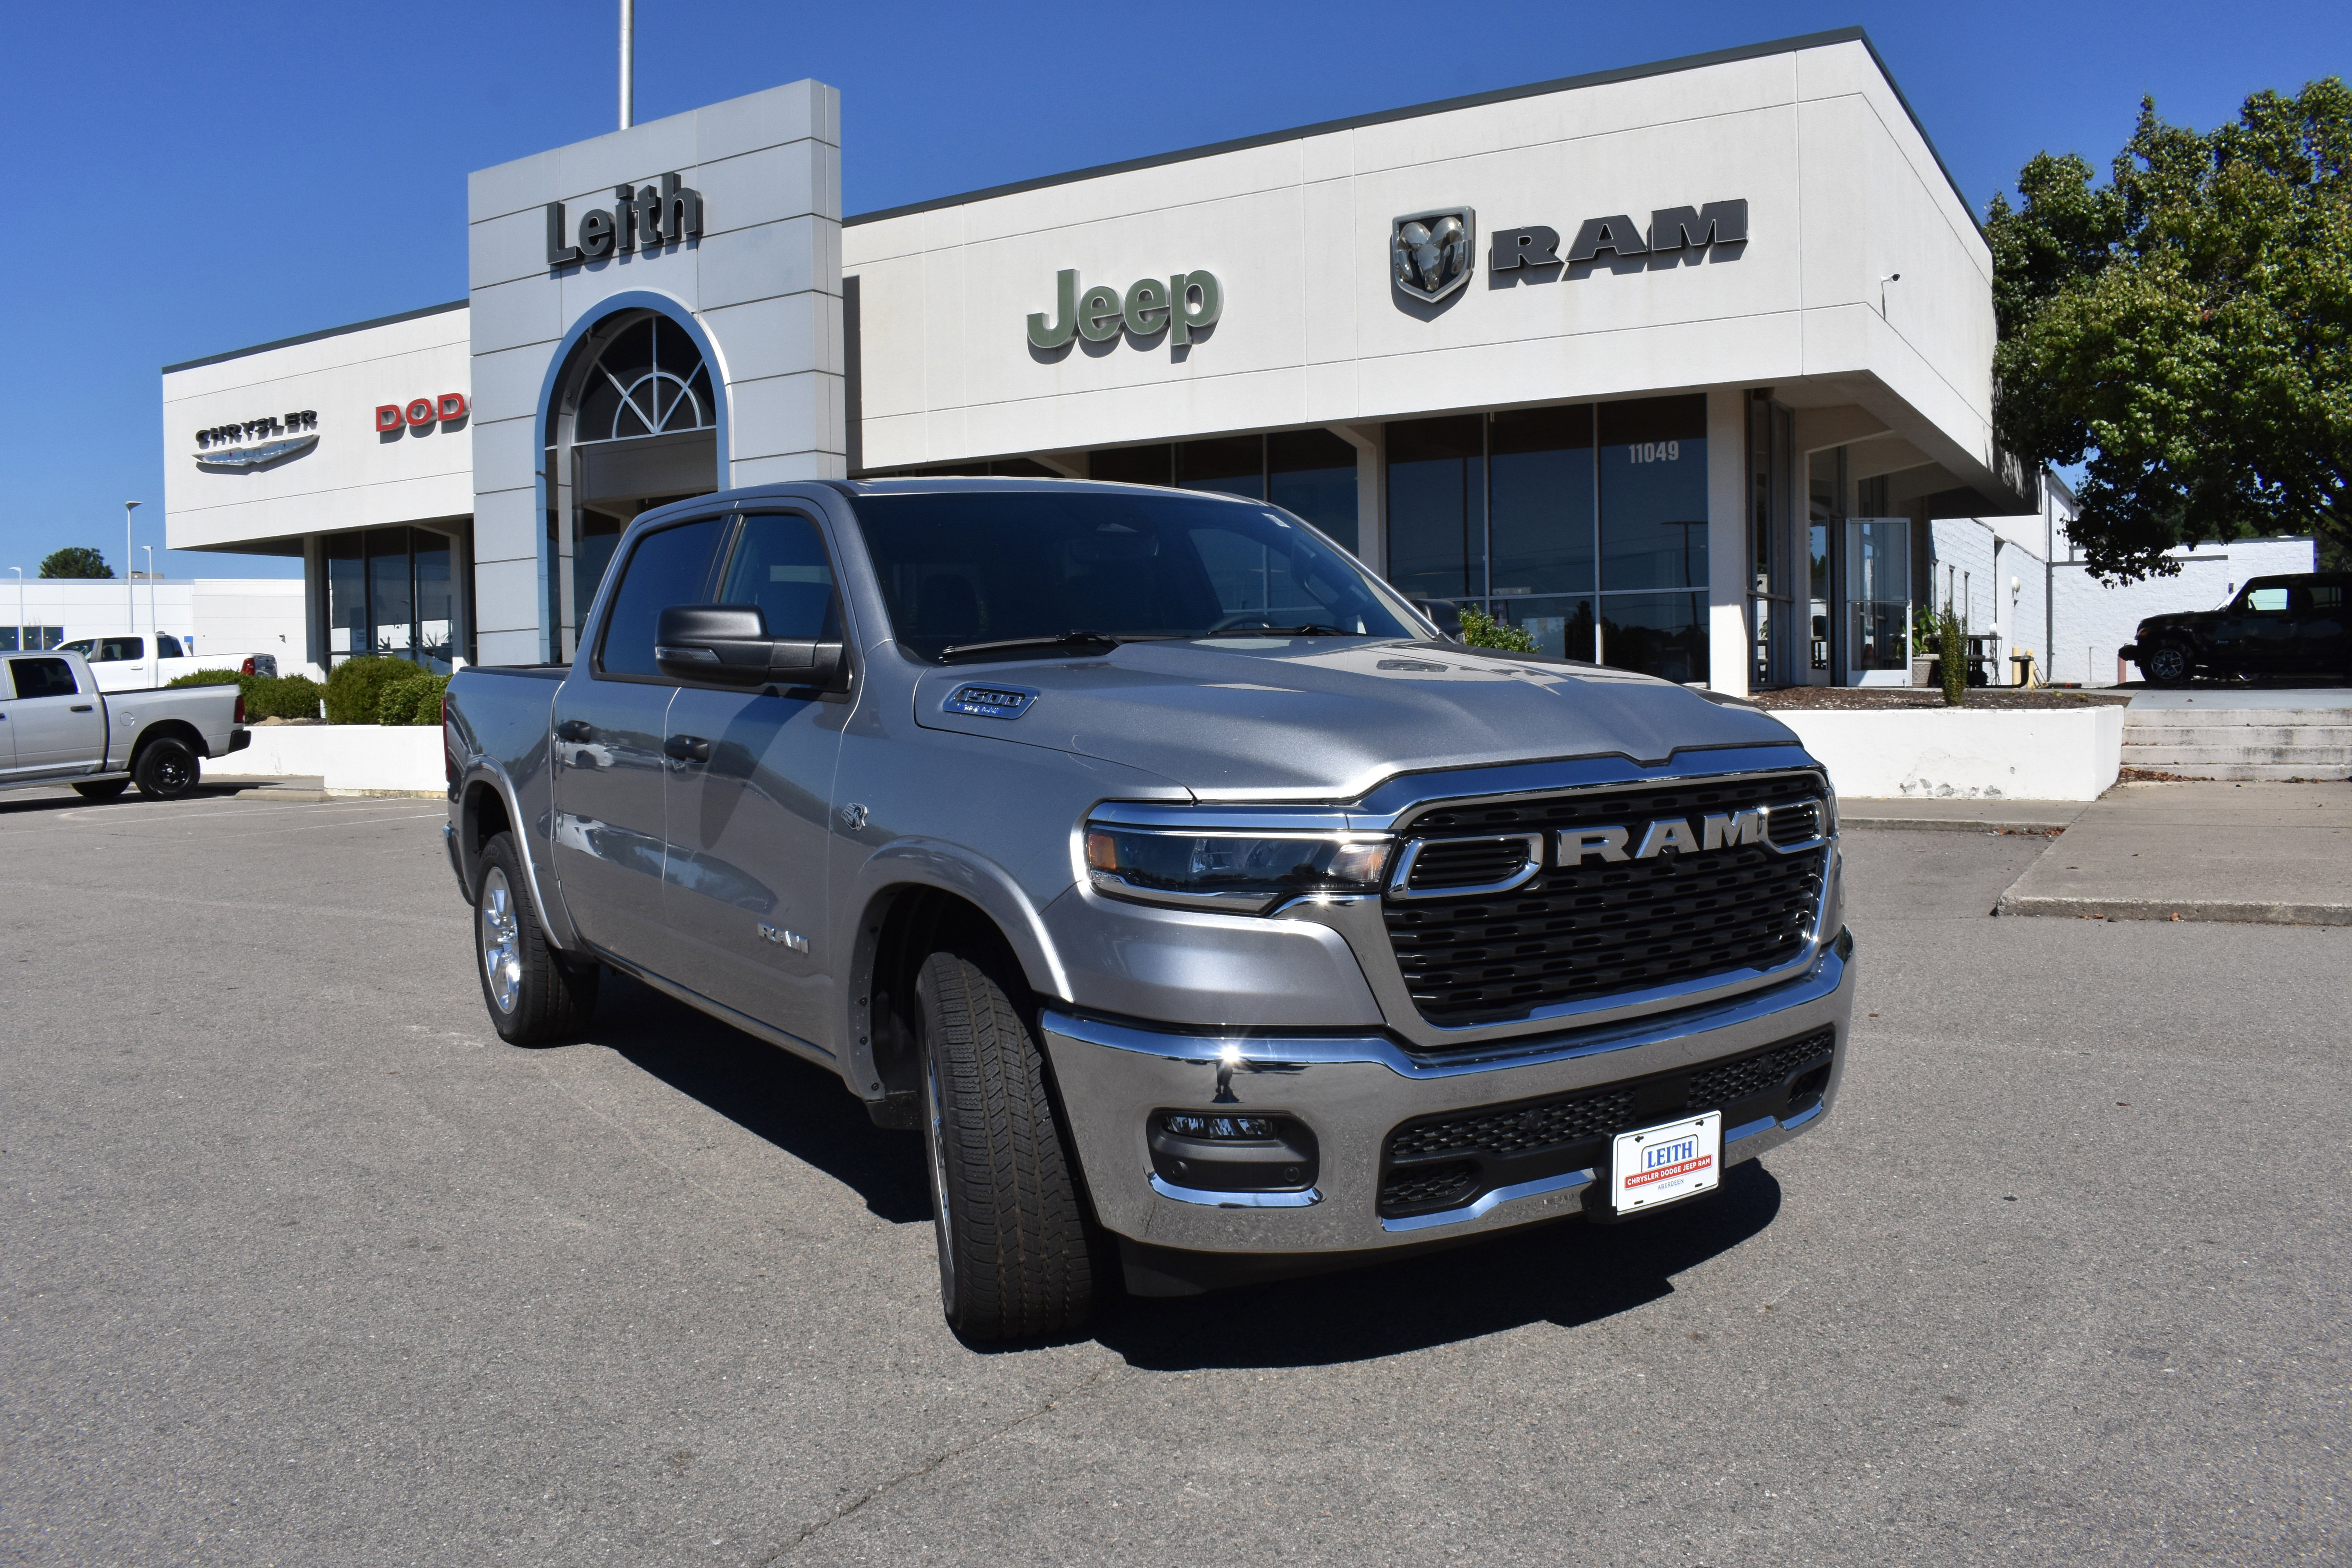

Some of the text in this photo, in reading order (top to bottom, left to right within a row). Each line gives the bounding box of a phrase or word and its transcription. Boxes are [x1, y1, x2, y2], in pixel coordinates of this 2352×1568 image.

[546, 172, 703, 265] Leith
[1491, 198, 1749, 272] RAM
[1027, 268, 1224, 349] Jeep
[195, 410, 318, 443] CHRYSLER
[376, 392, 471, 432] DOD
[1628, 441, 1679, 464] 11049
[961, 689, 1023, 707] 1500
[1556, 807, 1759, 866] RAM
[757, 921, 808, 953] RAM
[1647, 1141, 1693, 1168] LEITH
[1627, 1158, 1710, 1185] CHRYSLER DODGE JEEP RAM
[1657, 1178, 1684, 1190] ABERDEEN
